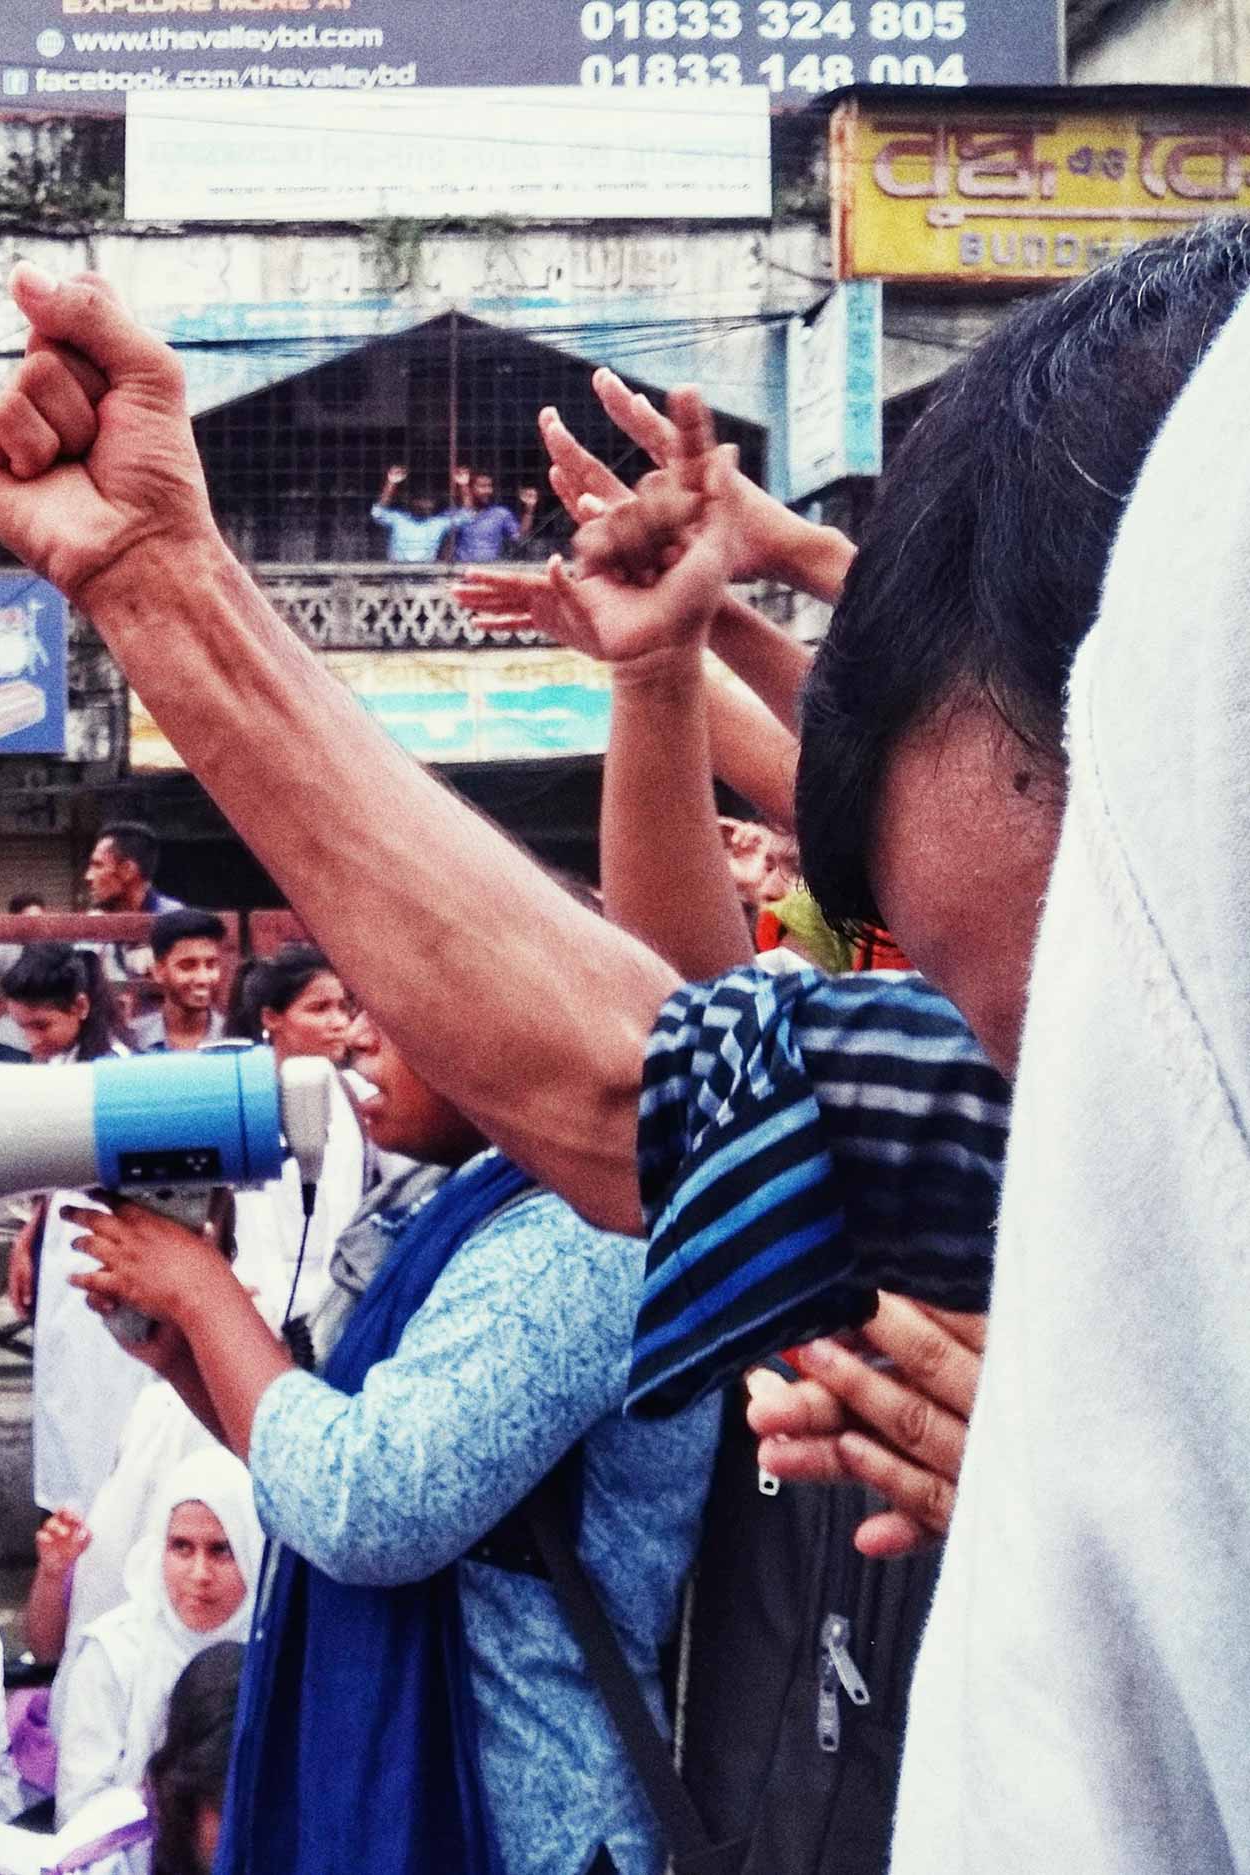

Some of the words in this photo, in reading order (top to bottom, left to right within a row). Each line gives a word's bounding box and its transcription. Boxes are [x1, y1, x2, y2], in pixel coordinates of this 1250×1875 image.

[580, 0, 743, 41] 01833
[757, 0, 856, 40] 324
[868, 0, 967, 41] 805
[71, 25, 384, 52] www.thevalleybd.com
[35, 62, 417, 92] facebook.com/thevalleybd
[580, 53, 743, 87] 01833
[757, 53, 856, 93] 148
[868, 53, 970, 87] 004
